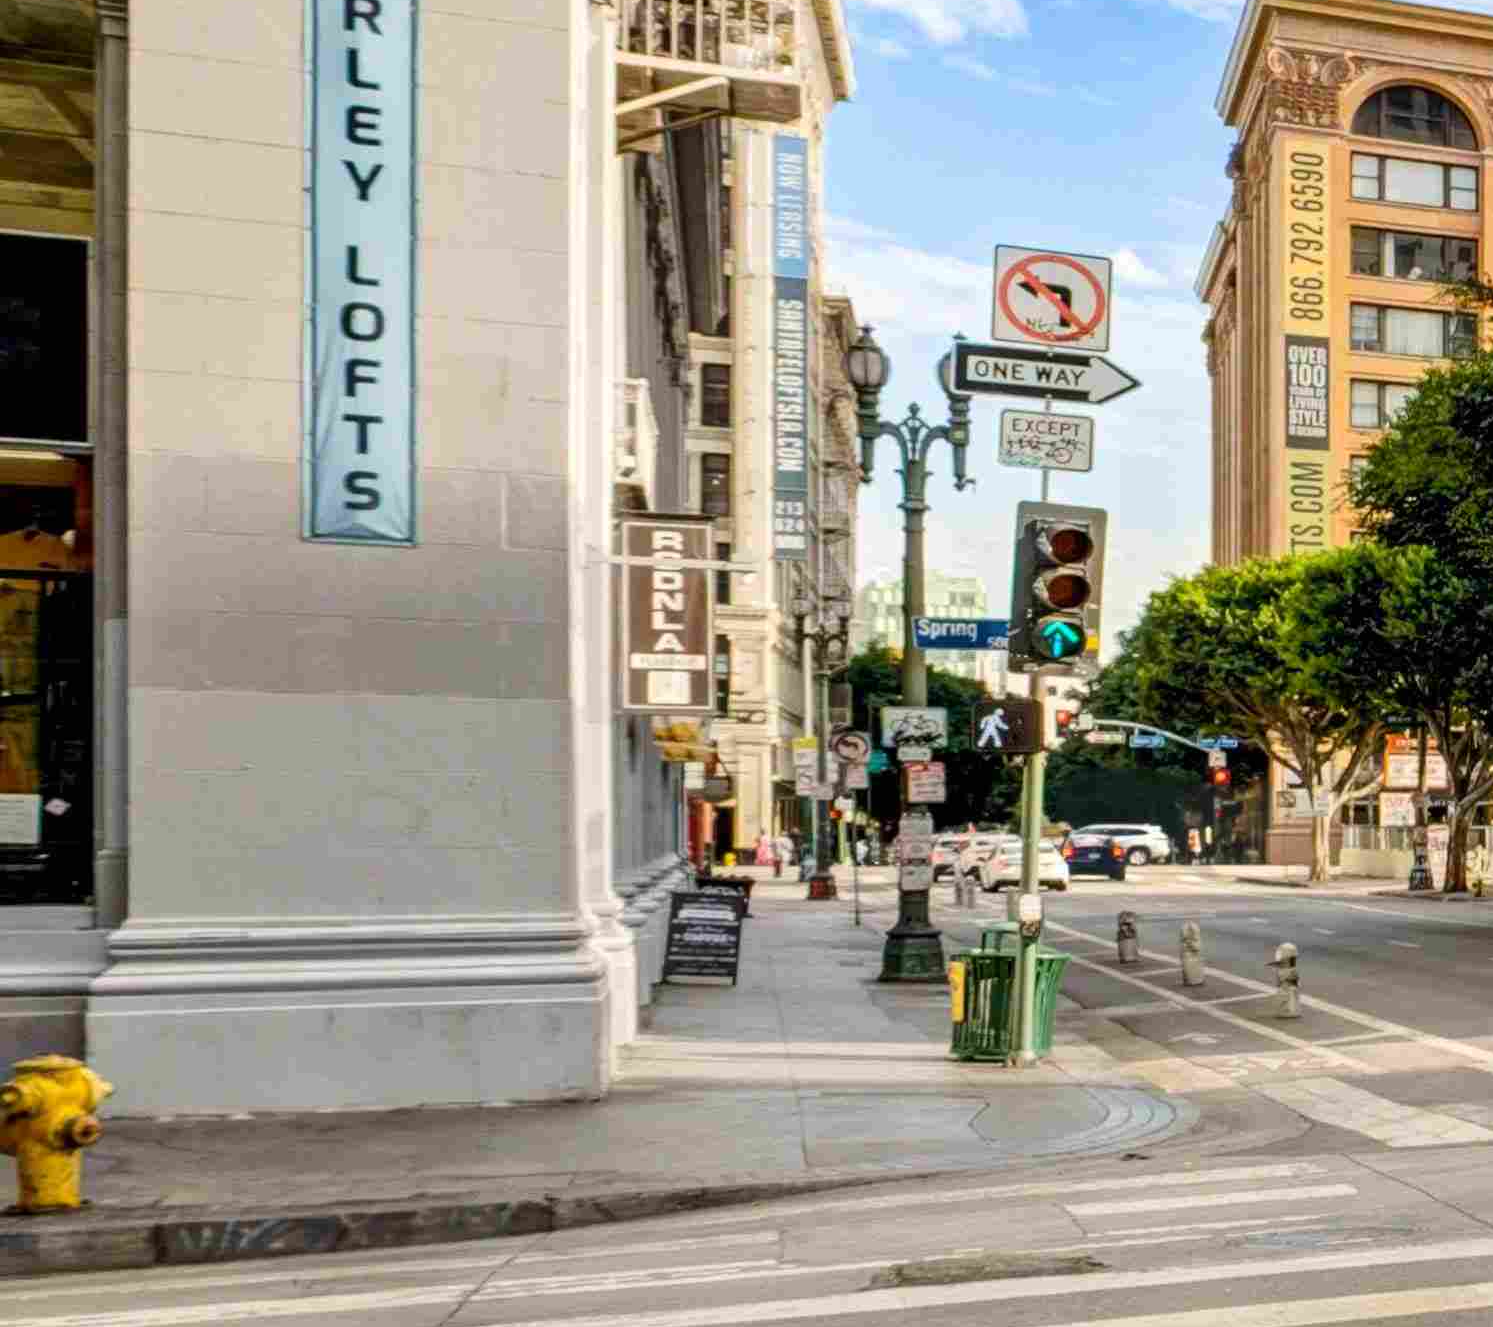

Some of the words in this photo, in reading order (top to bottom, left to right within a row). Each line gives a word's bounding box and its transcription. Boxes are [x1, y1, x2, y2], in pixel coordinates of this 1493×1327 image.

[777, 153, 804, 189] NOW
[777, 194, 804, 260] LEASING
[1290, 152, 1324, 322] 866.792.6590
[1288, 345, 1327, 365] OVER
[340, 244, 385, 513] LOFTS
[974, 360, 1025, 381] ONE
[1035, 366, 1086, 386] WAY
[1288, 364, 1326, 387] 100
[1012, 418, 1081, 438] EXCEPT
[917, 619, 978, 642] Spring
